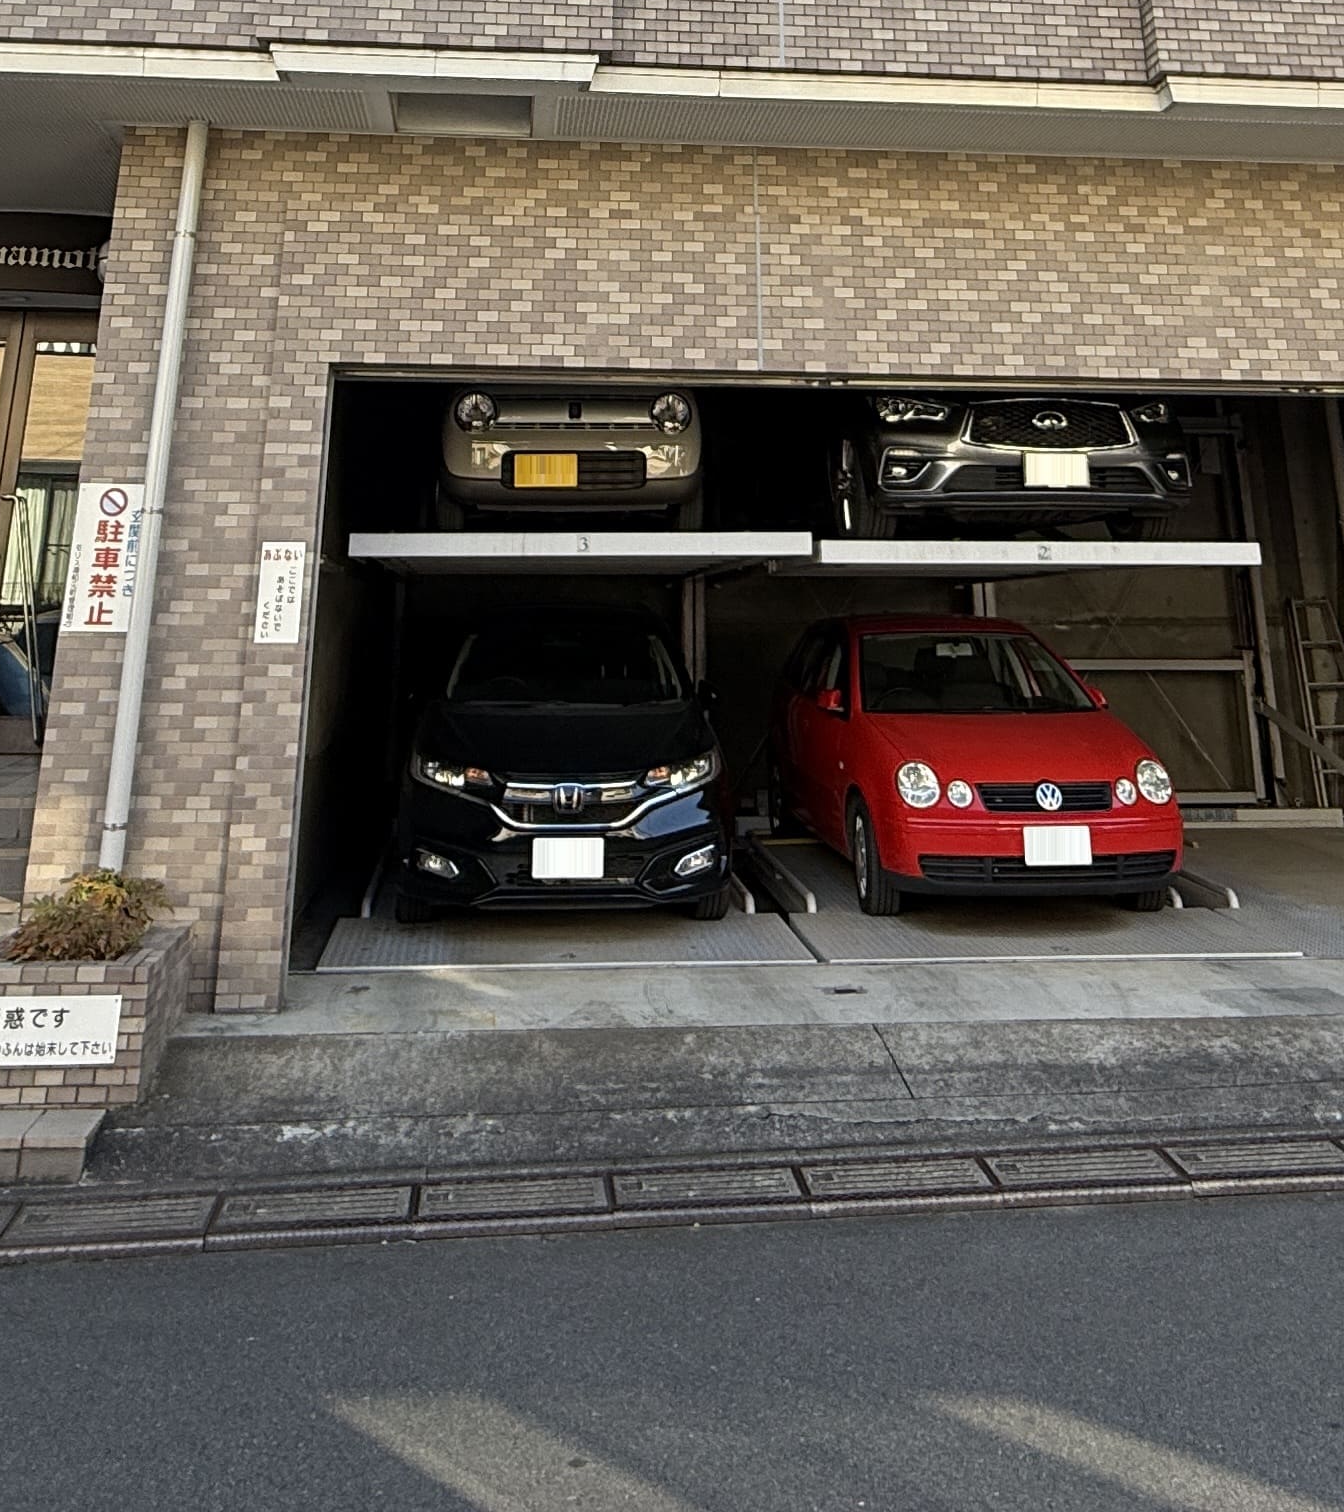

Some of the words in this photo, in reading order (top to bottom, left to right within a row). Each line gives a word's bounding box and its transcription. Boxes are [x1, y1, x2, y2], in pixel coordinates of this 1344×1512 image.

[83, 519, 125, 626] 駐車禁止
[578, 536, 589, 552] 3
